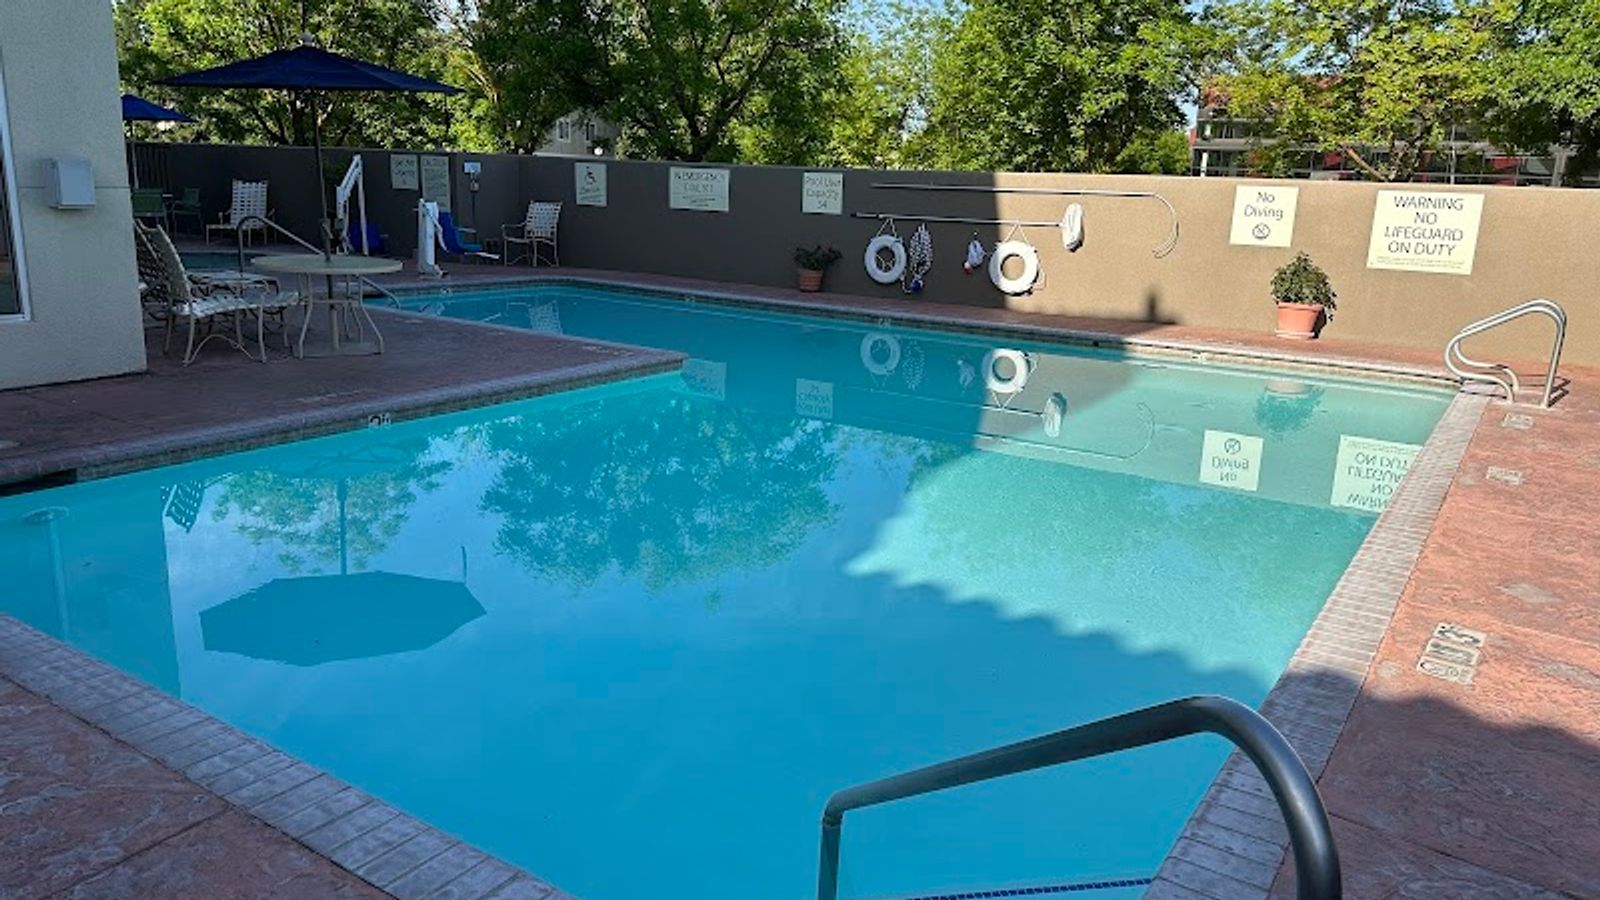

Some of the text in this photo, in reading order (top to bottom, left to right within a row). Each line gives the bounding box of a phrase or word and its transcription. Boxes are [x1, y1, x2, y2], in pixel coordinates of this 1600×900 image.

[1256, 191, 1276, 203] No
[1393, 195, 1465, 211] WARNING
[1244, 204, 1284, 221] Diving
[1414, 211, 1439, 225] NO
[1384, 226, 1464, 241] LIFEGUARD
[1388, 240, 1457, 256] ON DUTY
